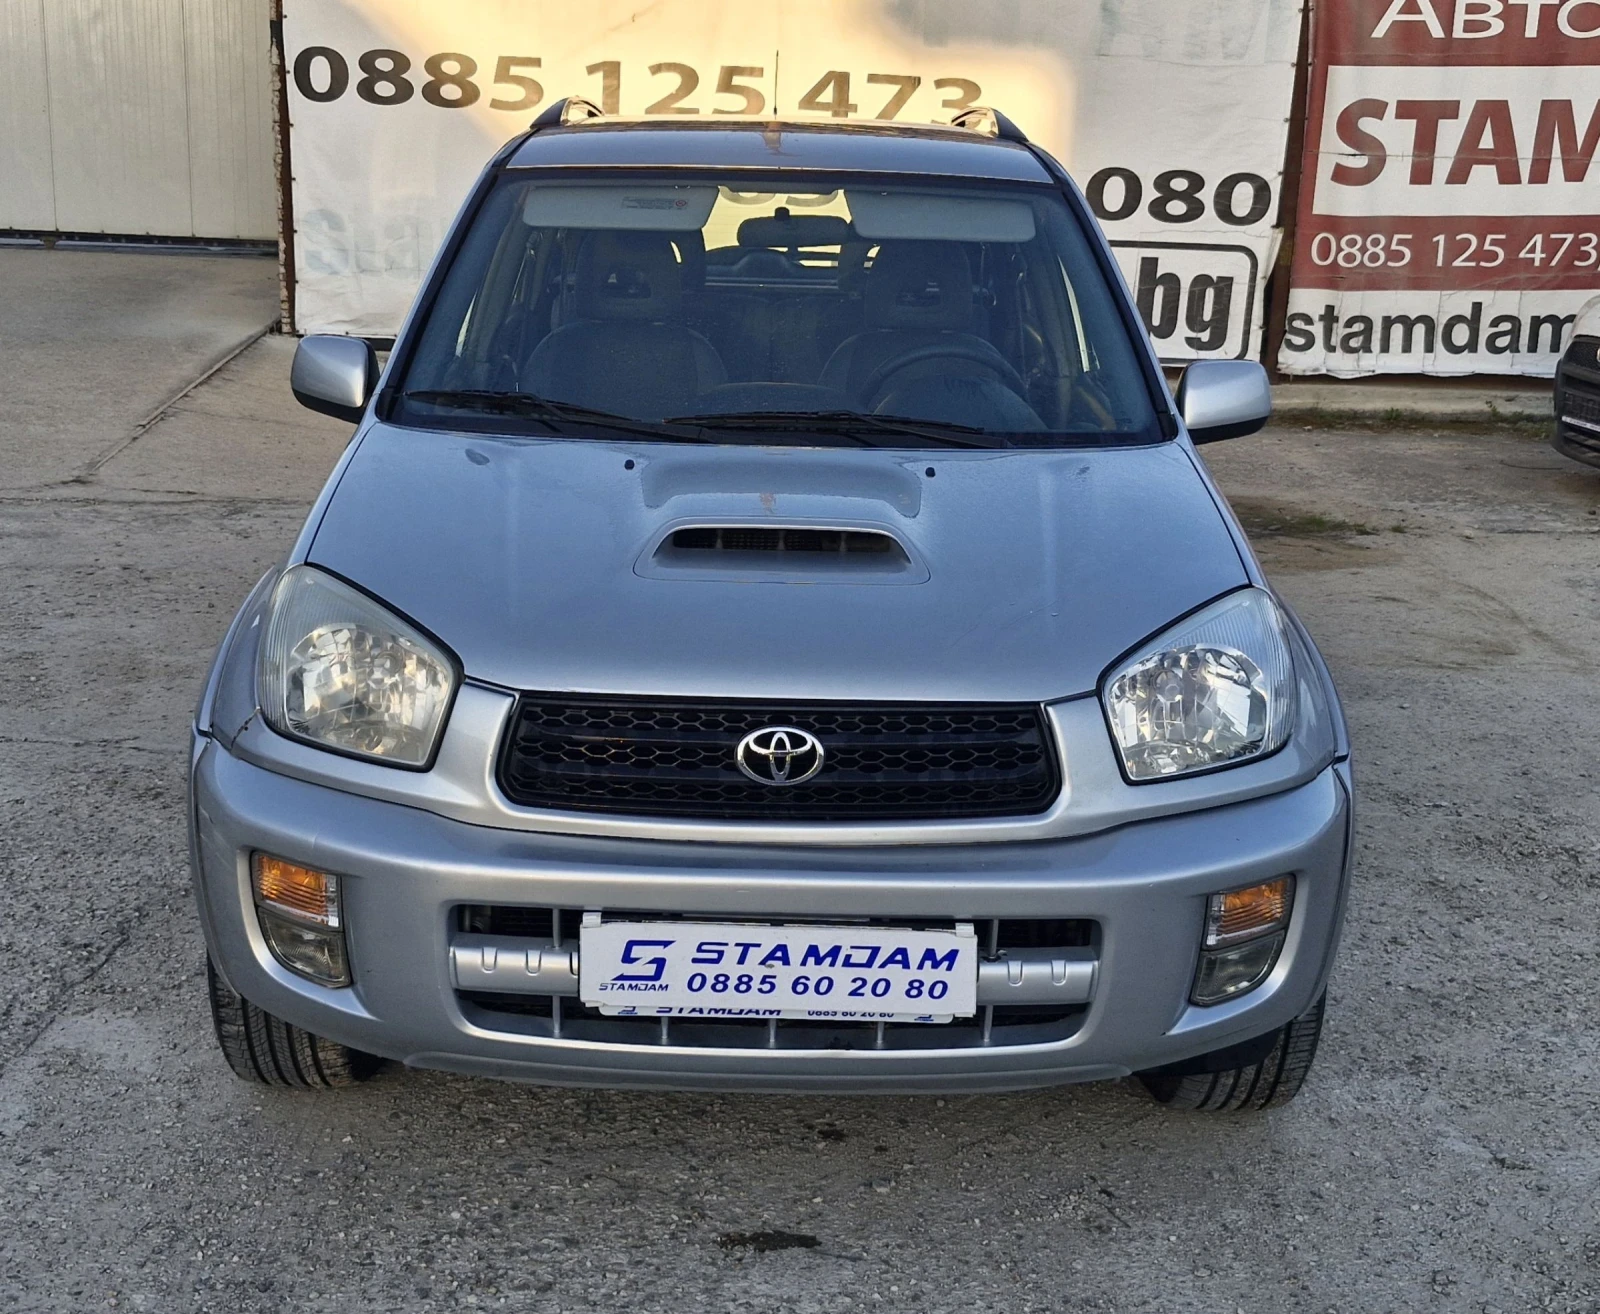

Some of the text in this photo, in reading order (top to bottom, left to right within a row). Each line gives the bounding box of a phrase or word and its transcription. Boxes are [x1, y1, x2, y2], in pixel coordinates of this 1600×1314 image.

[293, 46, 981, 126] 0885 125 473
[1330, 98, 1600, 187] STAM
[1085, 167, 1272, 226] 080
[1311, 232, 1413, 267] 0885
[1432, 233, 1507, 267] 125
[1136, 256, 1234, 351] bg
[1283, 301, 1577, 354] stamdam
[691, 942, 960, 972] STAMDAM
[687, 973, 949, 1000] 0885 60 20 80
